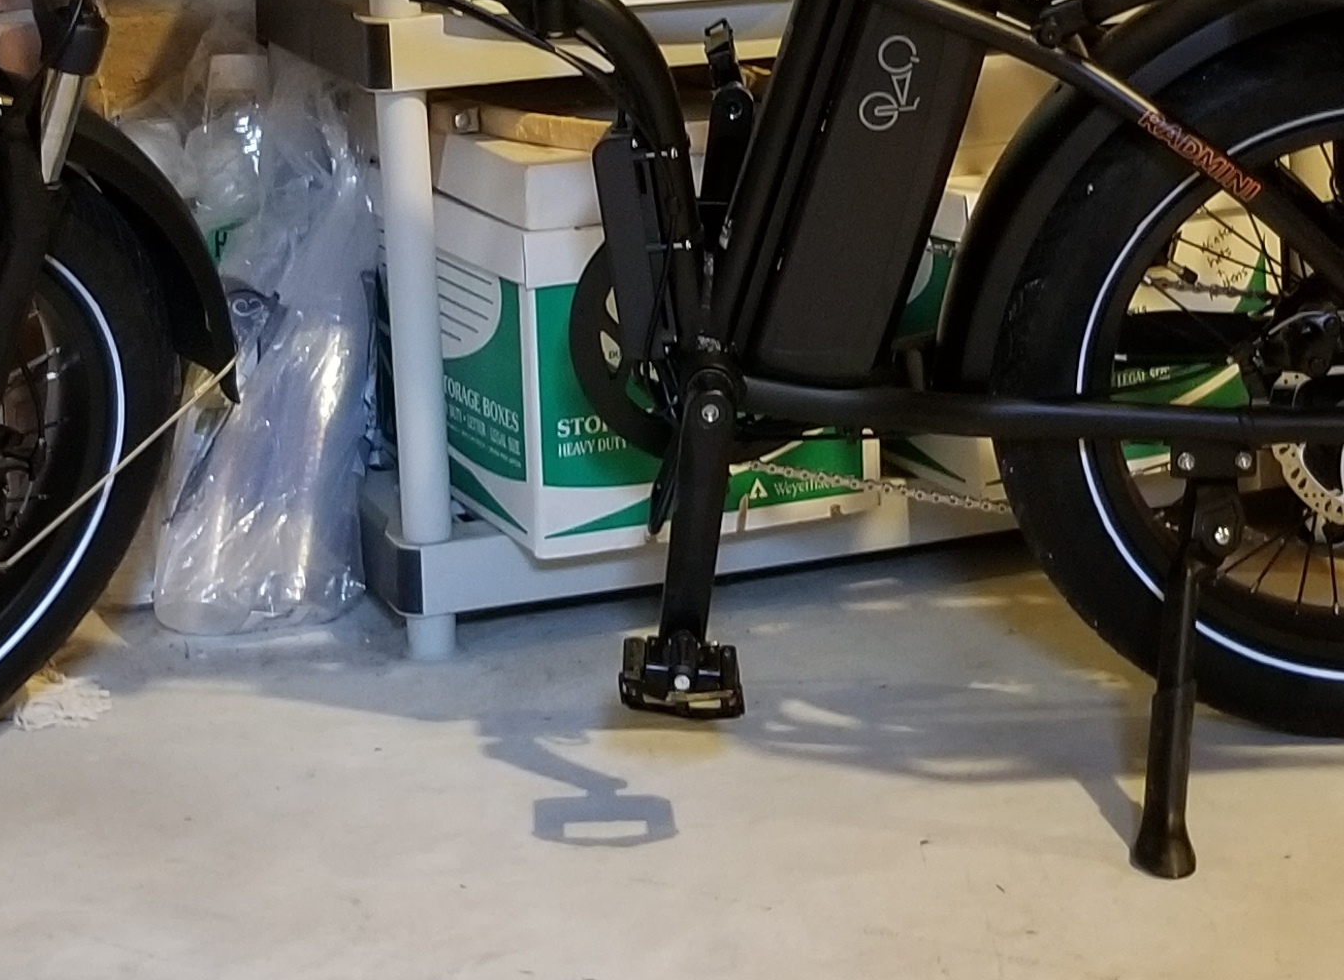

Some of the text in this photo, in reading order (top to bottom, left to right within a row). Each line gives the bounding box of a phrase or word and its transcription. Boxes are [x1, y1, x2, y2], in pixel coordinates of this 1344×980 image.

[1138, 109, 1262, 203] RADMINI
[444, 375, 519, 433] TORAGE BOXES
[558, 441, 594, 458] HEAVY
